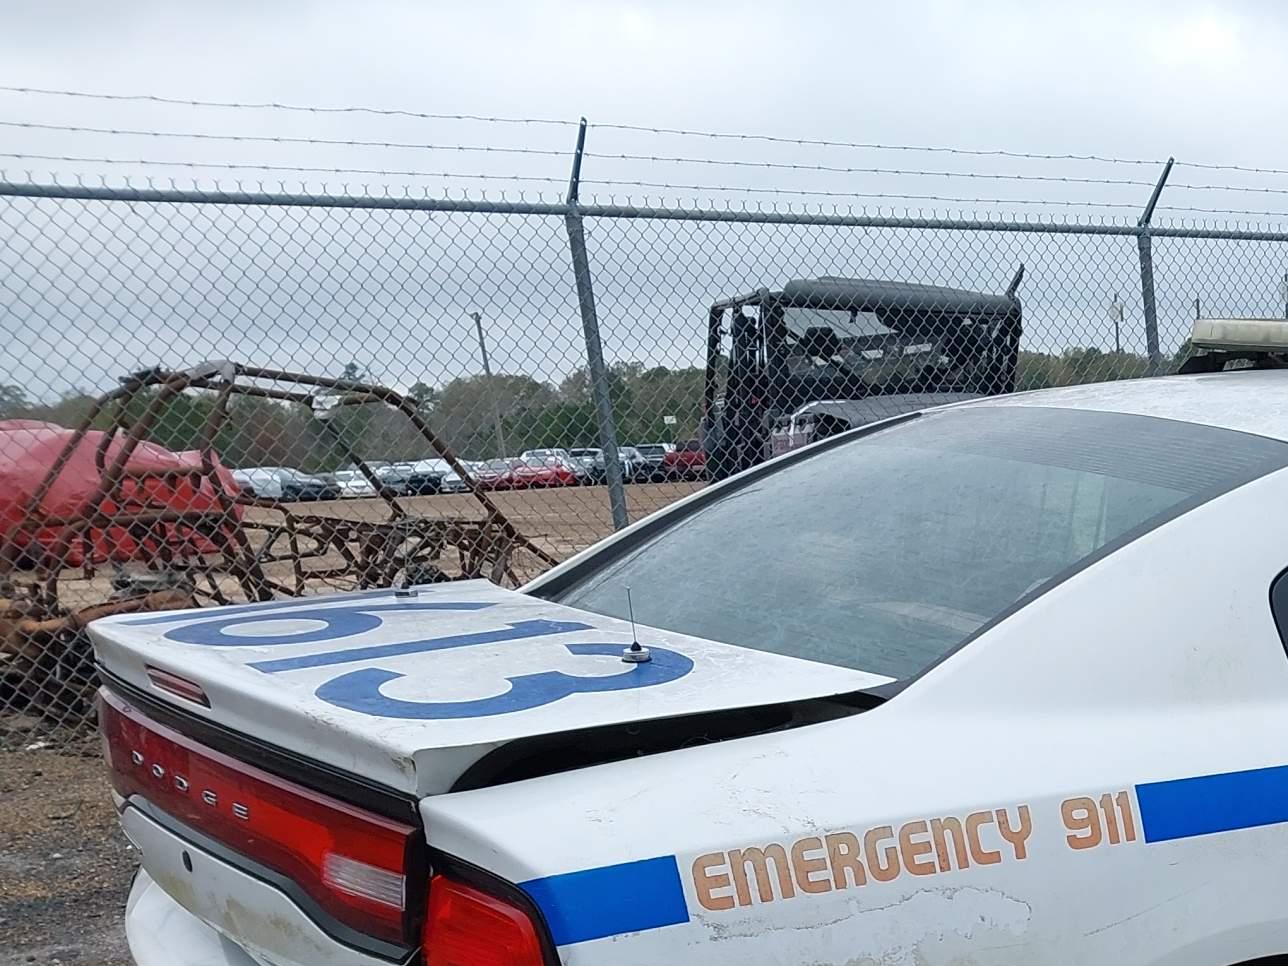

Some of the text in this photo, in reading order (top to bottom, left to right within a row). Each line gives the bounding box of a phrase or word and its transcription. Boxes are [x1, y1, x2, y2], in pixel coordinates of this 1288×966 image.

[131, 749, 249, 820] DODGE
[691, 790, 1136, 912] EMERGENCY 911
